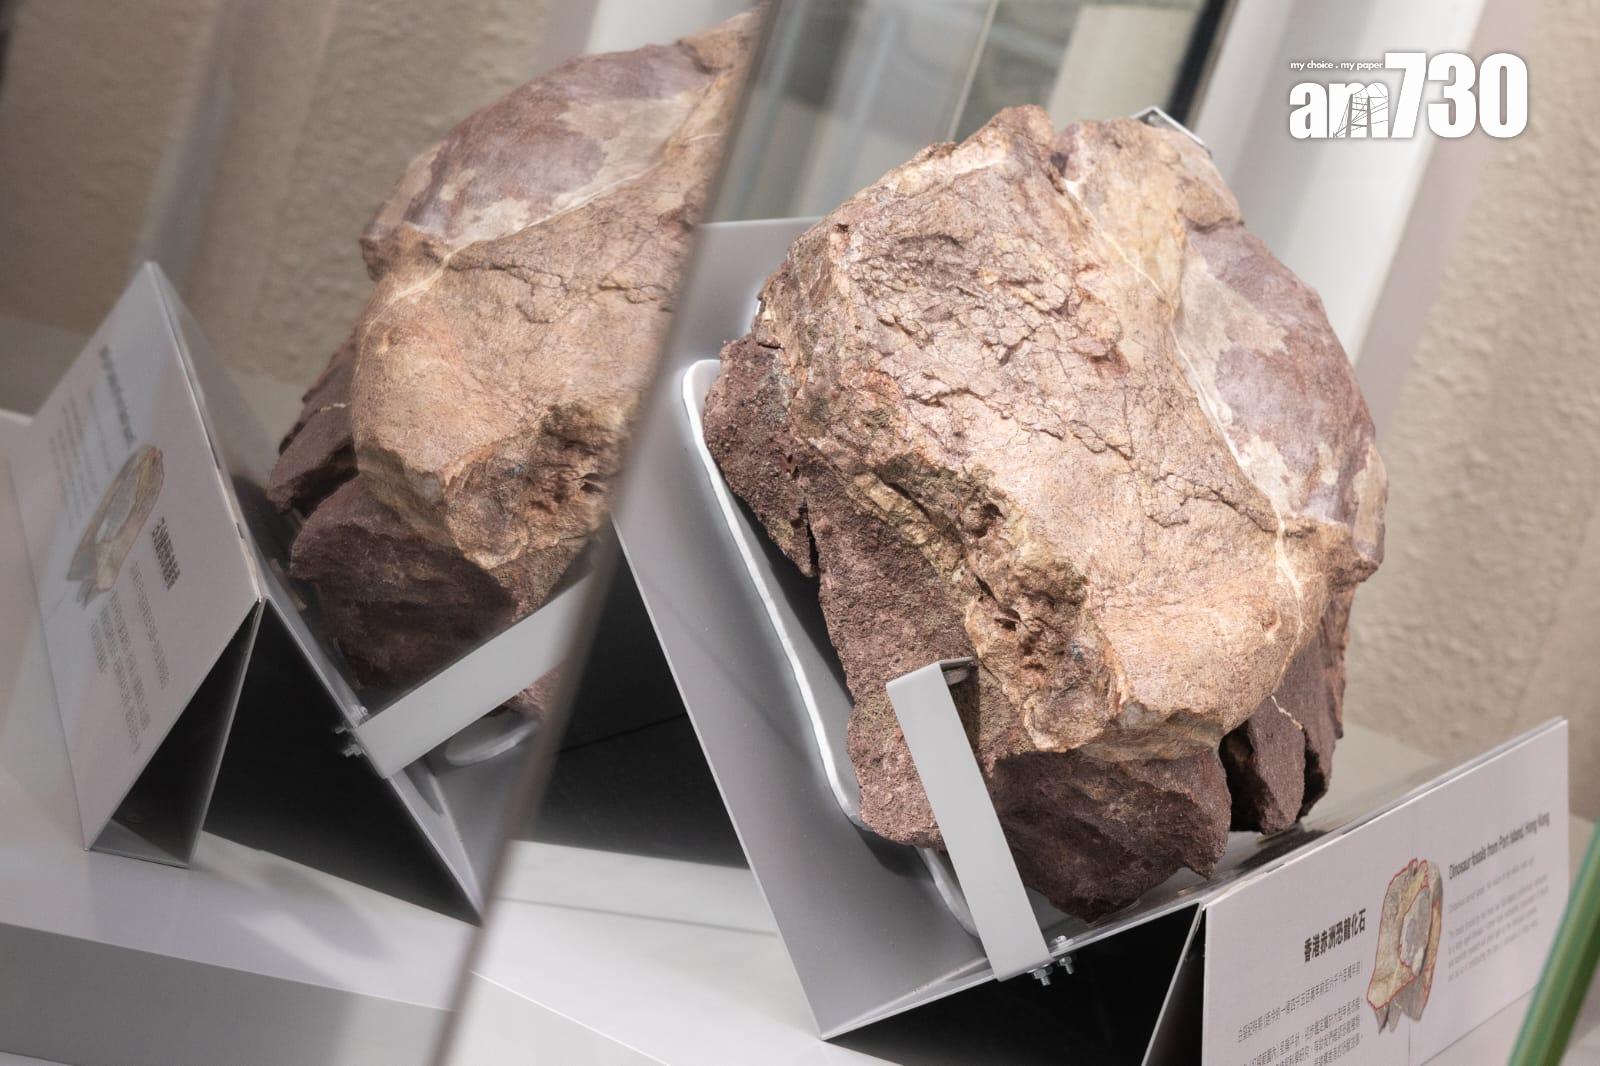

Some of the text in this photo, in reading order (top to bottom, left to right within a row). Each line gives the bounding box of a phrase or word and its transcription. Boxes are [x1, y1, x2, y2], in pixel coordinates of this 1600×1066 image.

[1449, 857, 1471, 880] Dinosaur
[1304, 908, 1366, 962] 香港赤洲恐龍化石
